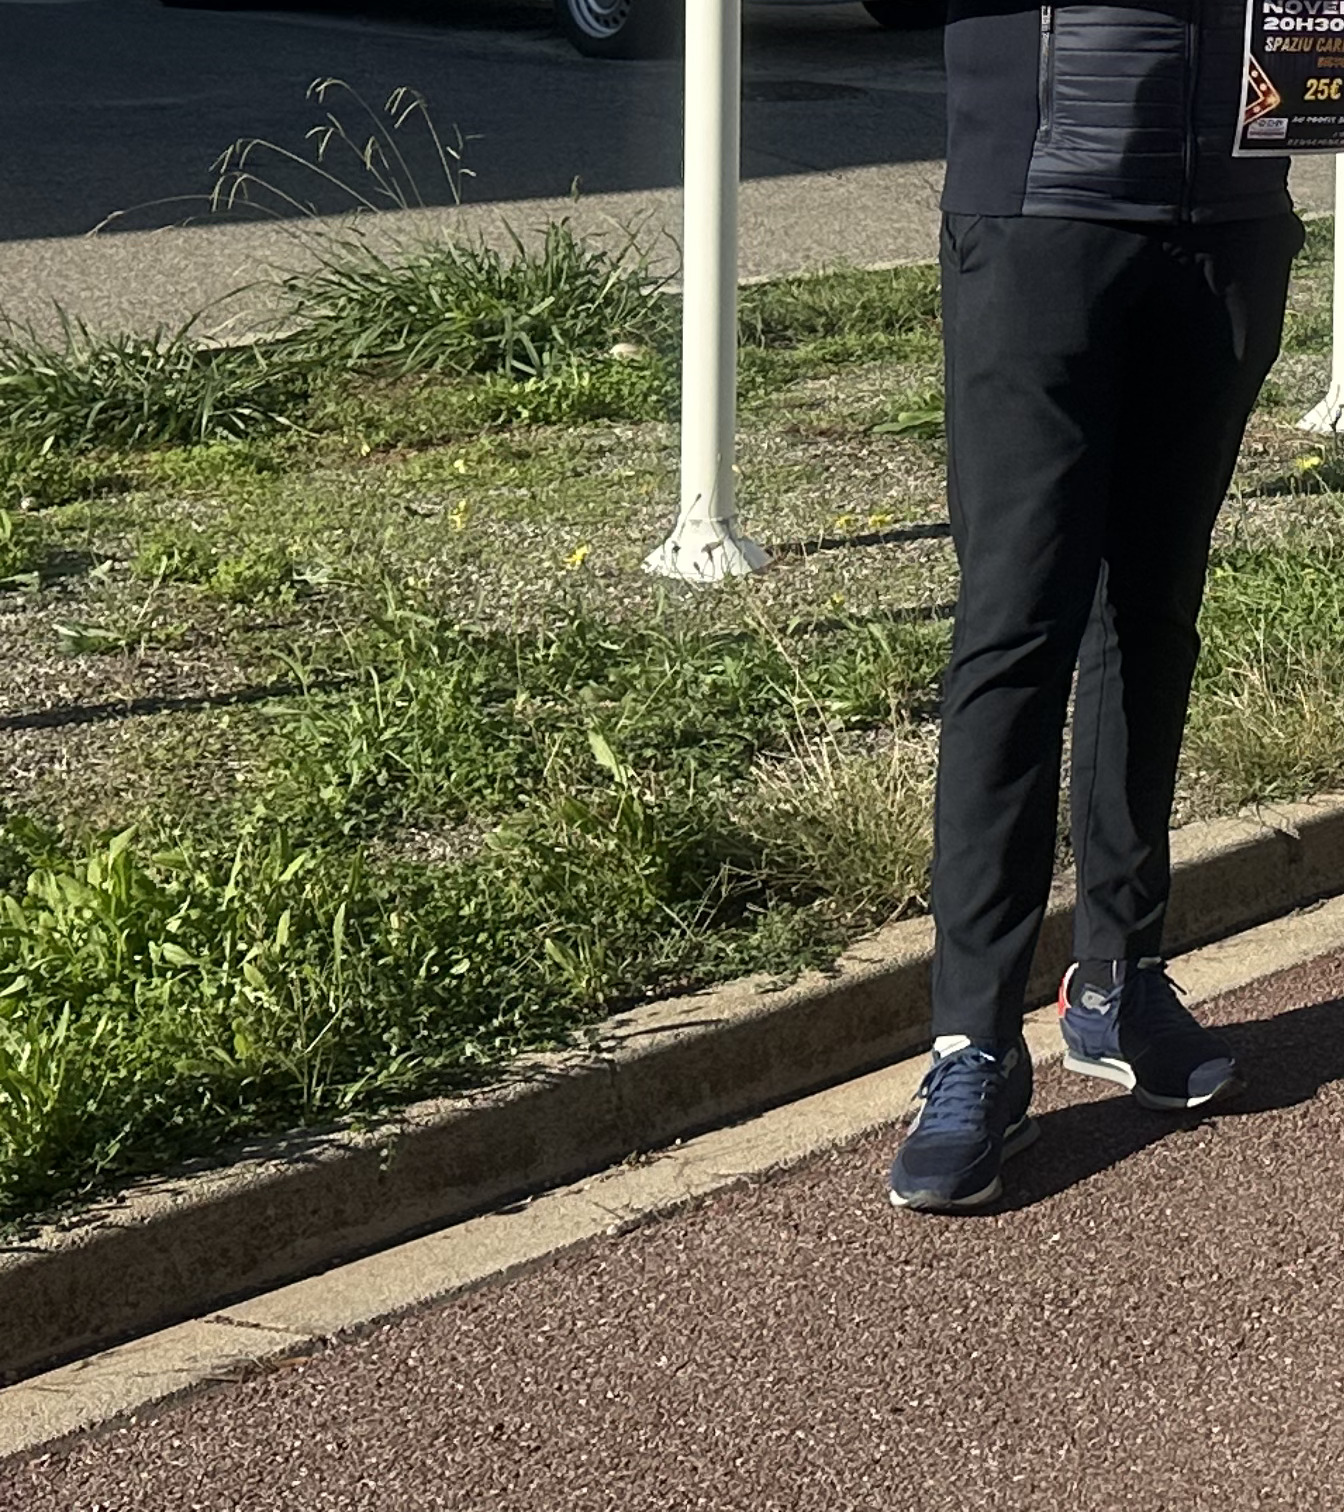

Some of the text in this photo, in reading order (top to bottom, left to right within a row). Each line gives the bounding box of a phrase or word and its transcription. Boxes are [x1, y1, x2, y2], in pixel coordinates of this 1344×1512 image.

[1263, 17, 1344, 32] 20H30
[1264, 36, 1314, 52] SPAZIU
[1303, 77, 1344, 101] 25€
